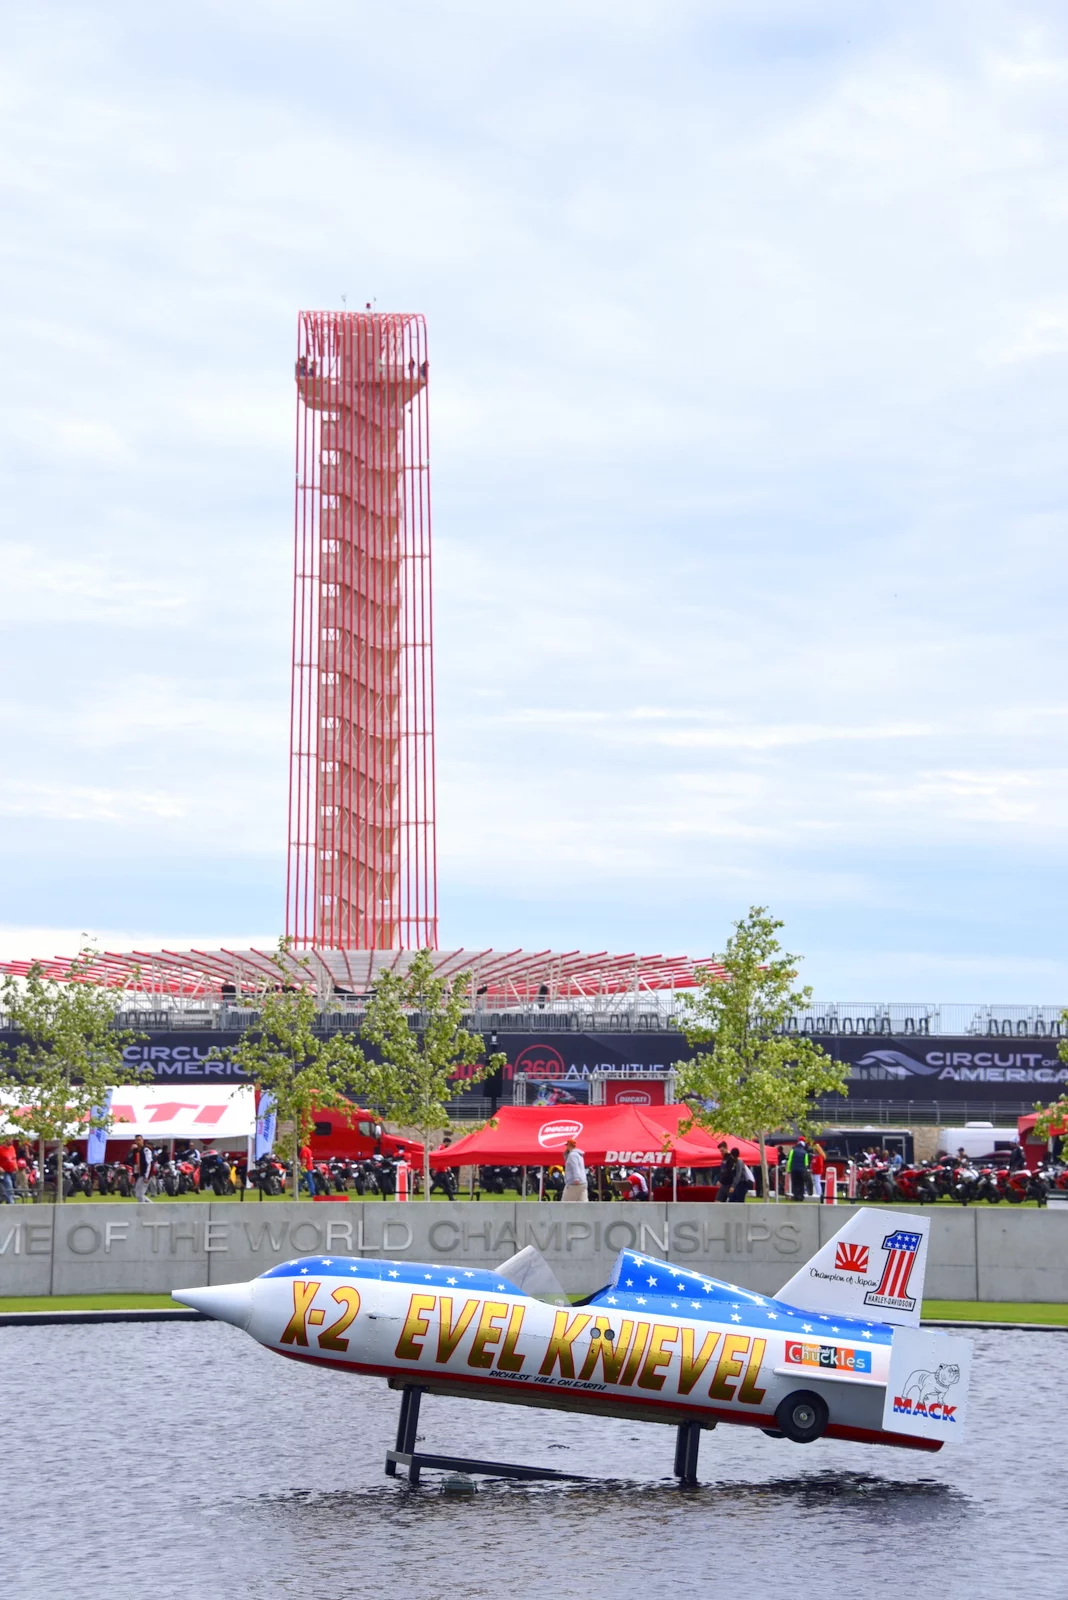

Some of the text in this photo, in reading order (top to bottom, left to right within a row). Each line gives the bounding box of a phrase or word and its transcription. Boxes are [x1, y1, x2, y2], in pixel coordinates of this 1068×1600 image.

[122, 1046, 243, 1060] CIRCUIT
[925, 1052, 1042, 1066] CIRCUIT
[137, 1061, 259, 1075] AMERIC
[448, 1063, 514, 1080] ausn
[520, 1059, 560, 1080] 360
[619, 1095, 647, 1104] DUCATI
[544, 1125, 579, 1133] DUCATI
[605, 1150, 673, 1164] DUCATI
[67, 1220, 129, 1255] OF
[142, 1220, 229, 1253] THE
[243, 1219, 414, 1252] WORLD
[428, 1219, 801, 1254] CHAMPIONSHIPS
[845, 1275, 853, 1284] of
[867, 1295, 913, 1308] HARLEY-DAVIDSON
[280, 1280, 767, 1405] X-2 EVEL KNIEVEL
[788, 1344, 866, 1369] Chuckles
[489, 1370, 532, 1381] RICHEST
[573, 1380, 607, 1391] EARTH
[893, 1396, 957, 1423] MACK
